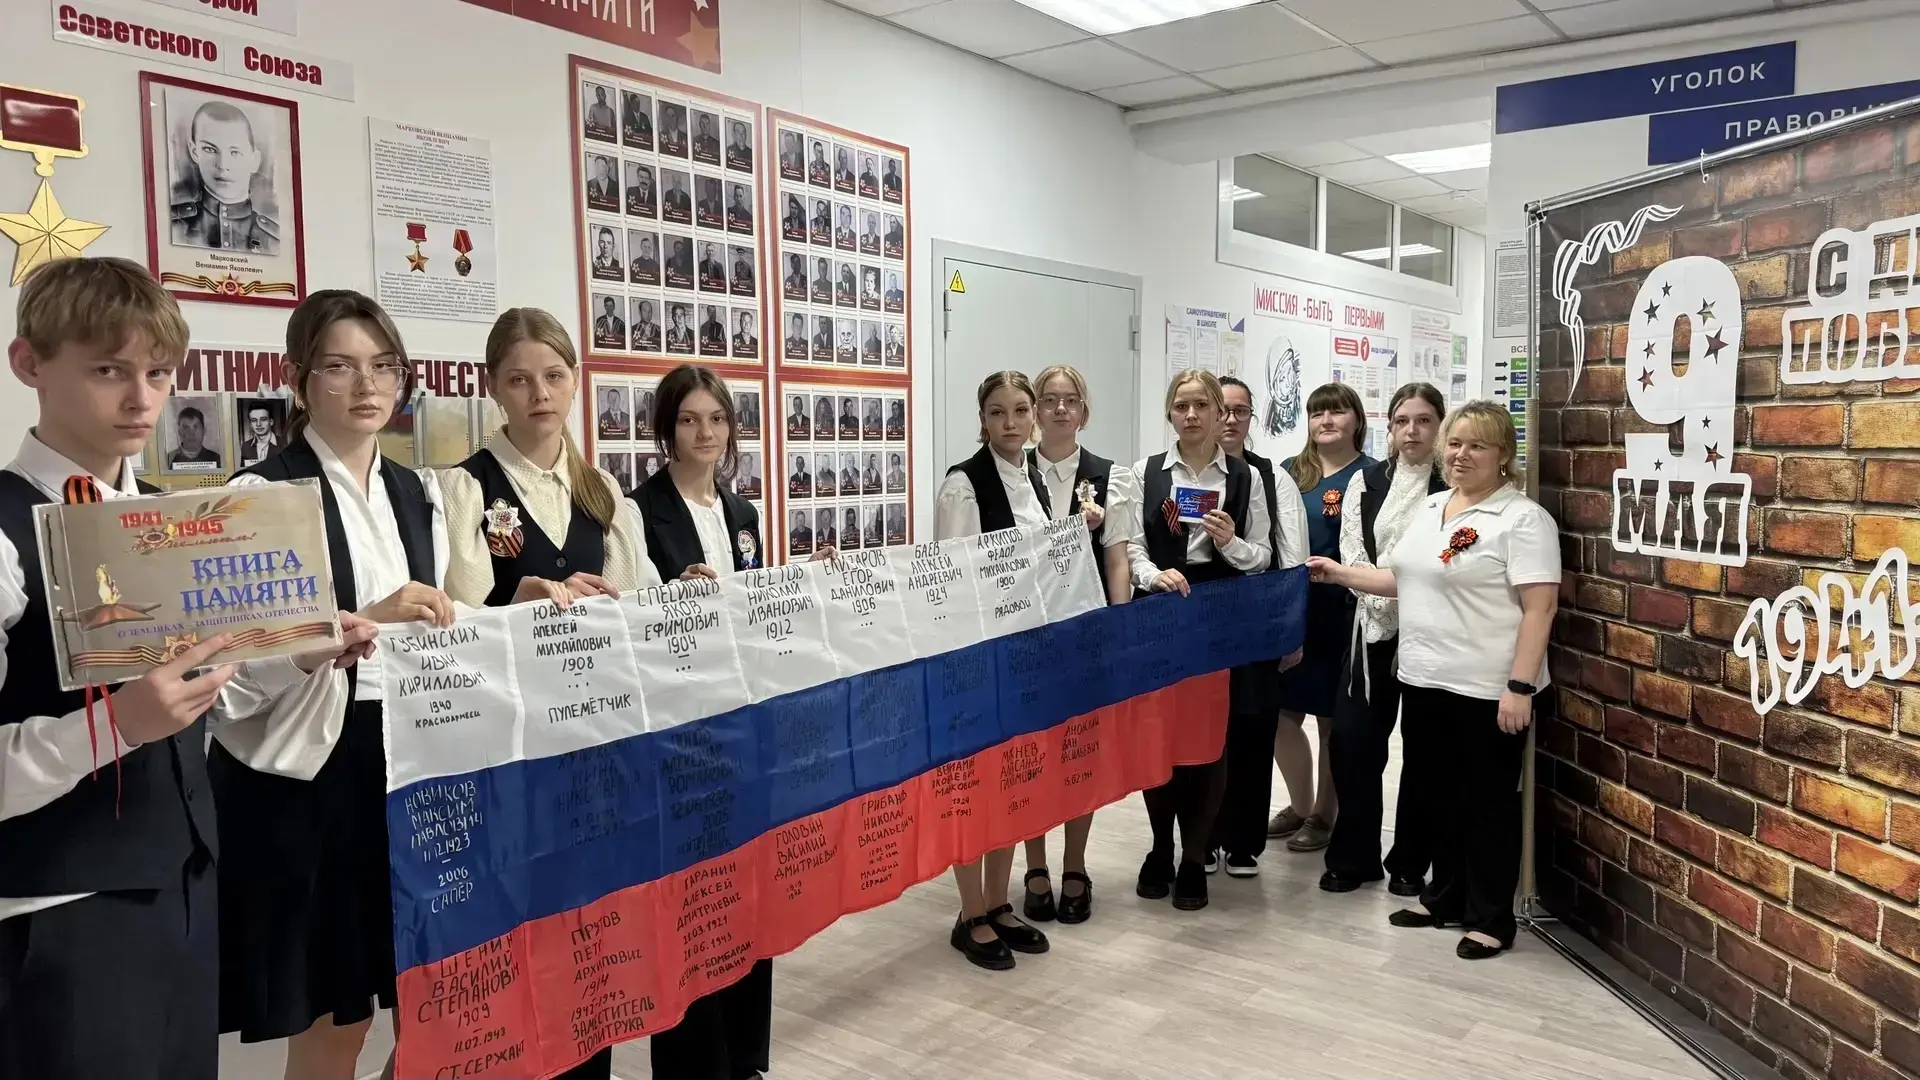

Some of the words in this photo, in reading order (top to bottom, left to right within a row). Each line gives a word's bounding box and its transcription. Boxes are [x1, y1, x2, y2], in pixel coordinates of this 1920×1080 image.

[59, 4, 218, 62] Советского
[244, 46, 322, 85] Союза
[1651, 61, 1766, 95] УГОЛОК
[1725, 103, 1893, 139] ПРАВОВ
[195, 261, 228, 270] Вениамин
[229, 264, 263, 273] Яковлевич
[210, 254, 248, 263] Марковский
[1811, 233, 1850, 301] С
[1256, 288, 1298, 316] МИССИЯ
[1344, 305, 1385, 331] ПЕРВЫМИ
[1625, 255, 1742, 474] 9
[175, 518, 224, 538] 1945
[1614, 473, 1750, 561] МАЯ
[914, 541, 940, 558] БАЕВ
[977, 528, 1023, 550] АРХИПОВ
[190, 549, 303, 580] КНИГА
[823, 549, 886, 575] ЕЛИЗАРОВ
[911, 554, 953, 575] АЛЕКСЕЙ
[979, 557, 1031, 579] МИХАЙЛОВИЧ
[745, 564, 804, 589] ПЕСТОВ
[842, 569, 873, 587] ЕГОР
[908, 568, 963, 590] АНДРЕЕВИЧ
[996, 577, 1016, 588] 1900
[180, 576, 318, 613] ПАМЯТИ
[637, 577, 720, 607] СПЕСИВЦЕВ
[747, 580, 802, 606] НИКОЛАЙ
[831, 580, 895, 601] ДАНИЛОВИЧ
[926, 587, 948, 604] 1924
[662, 600, 702, 620] ЯКОВ
[747, 595, 814, 626] ИВАНОВИЧ
[852, 597, 876, 613] 1906
[994, 596, 1032, 619] РЯДОВОЙ
[129, 622, 185, 637] ЗЕМЛЯКАХ
[194, 612, 263, 629] ЗАЩИТНИКАХ
[265, 605, 320, 619] ОТЕЧЕСТВА
[533, 619, 577, 639] АЛЕКСЕЙ
[644, 611, 719, 641] ЕФИМОВИЧ
[766, 619, 794, 640] 1912
[390, 625, 480, 652] ГУБИНСКИХ
[536, 636, 612, 657] МИХАЙЛОВИЧ
[667, 634, 697, 654] 1904
[421, 654, 460, 671] ИВАН
[562, 656, 595, 673] 1908
[399, 671, 488, 697] КИРИЛЛОВИЧ
[548, 693, 632, 723] ПУЛЕМЁТЧИК
[404, 780, 477, 815] НОВИКОВ
[411, 797, 474, 830] МАКСИМ
[776, 819, 824, 848] ГОЛОВИН
[777, 834, 826, 864] ВАСИЛИЙ
[438, 866, 469, 887] 2006
[684, 861, 736, 891] ГАРАНИН
[682, 878, 733, 910] АЛЕКСЕЙ
[676, 892, 742, 931] ДМИТРИЕВИЧ
[441, 933, 513, 978] ШЕНИН
[707, 956, 747, 980] РОВЩИК
[432, 950, 513, 999] ВАСИЛИЙ
[581, 973, 609, 1000] 1914
[418, 962, 520, 1024] СТЕПАНОВИЧ
[457, 1003, 491, 1028] 1909
[572, 996, 655, 1041] ЗАМЕСТИТЕЛЬ
[578, 1016, 645, 1057] ПОЛИТРУКА
[463, 1039, 525, 1075] СЕРЖАНТ
